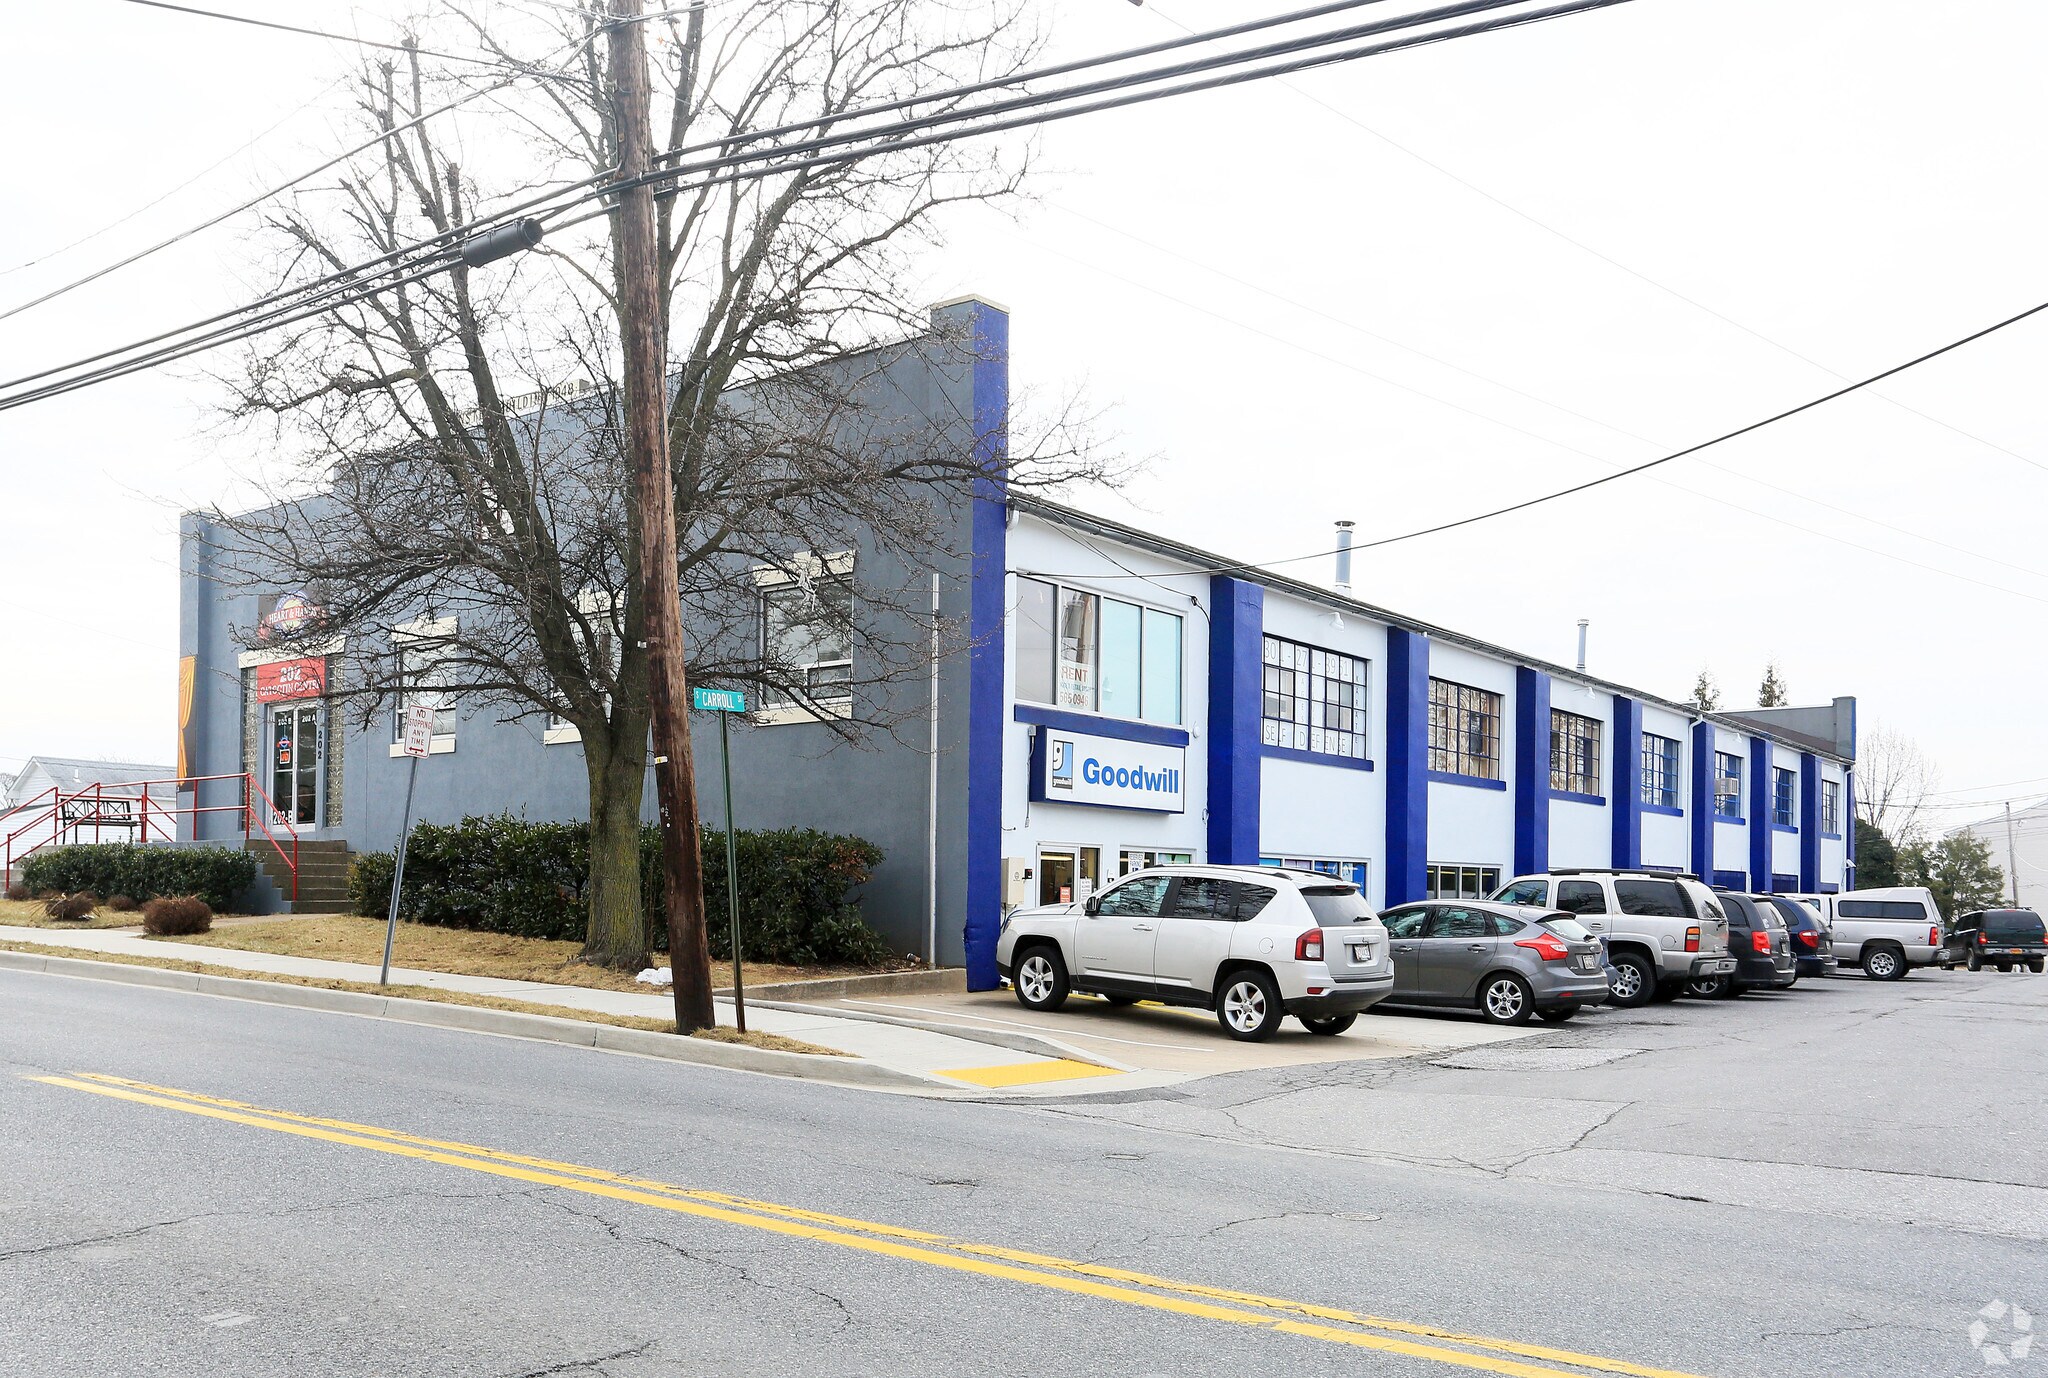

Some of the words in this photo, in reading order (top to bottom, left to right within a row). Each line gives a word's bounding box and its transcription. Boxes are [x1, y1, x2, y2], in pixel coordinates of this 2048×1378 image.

[269, 610, 288, 624] HEART
[288, 608, 295, 618] &
[279, 664, 302, 682] 202
[1061, 665, 1088, 682] RENT
[695, 690, 700, 699] S
[702, 691, 735, 709] CARROLL
[415, 709, 427, 719] NO
[408, 718, 432, 729] STOPPING
[411, 737, 425, 746] TIME
[1264, 724, 1287, 743] SEF
[1083, 757, 1179, 794] Goodwill
